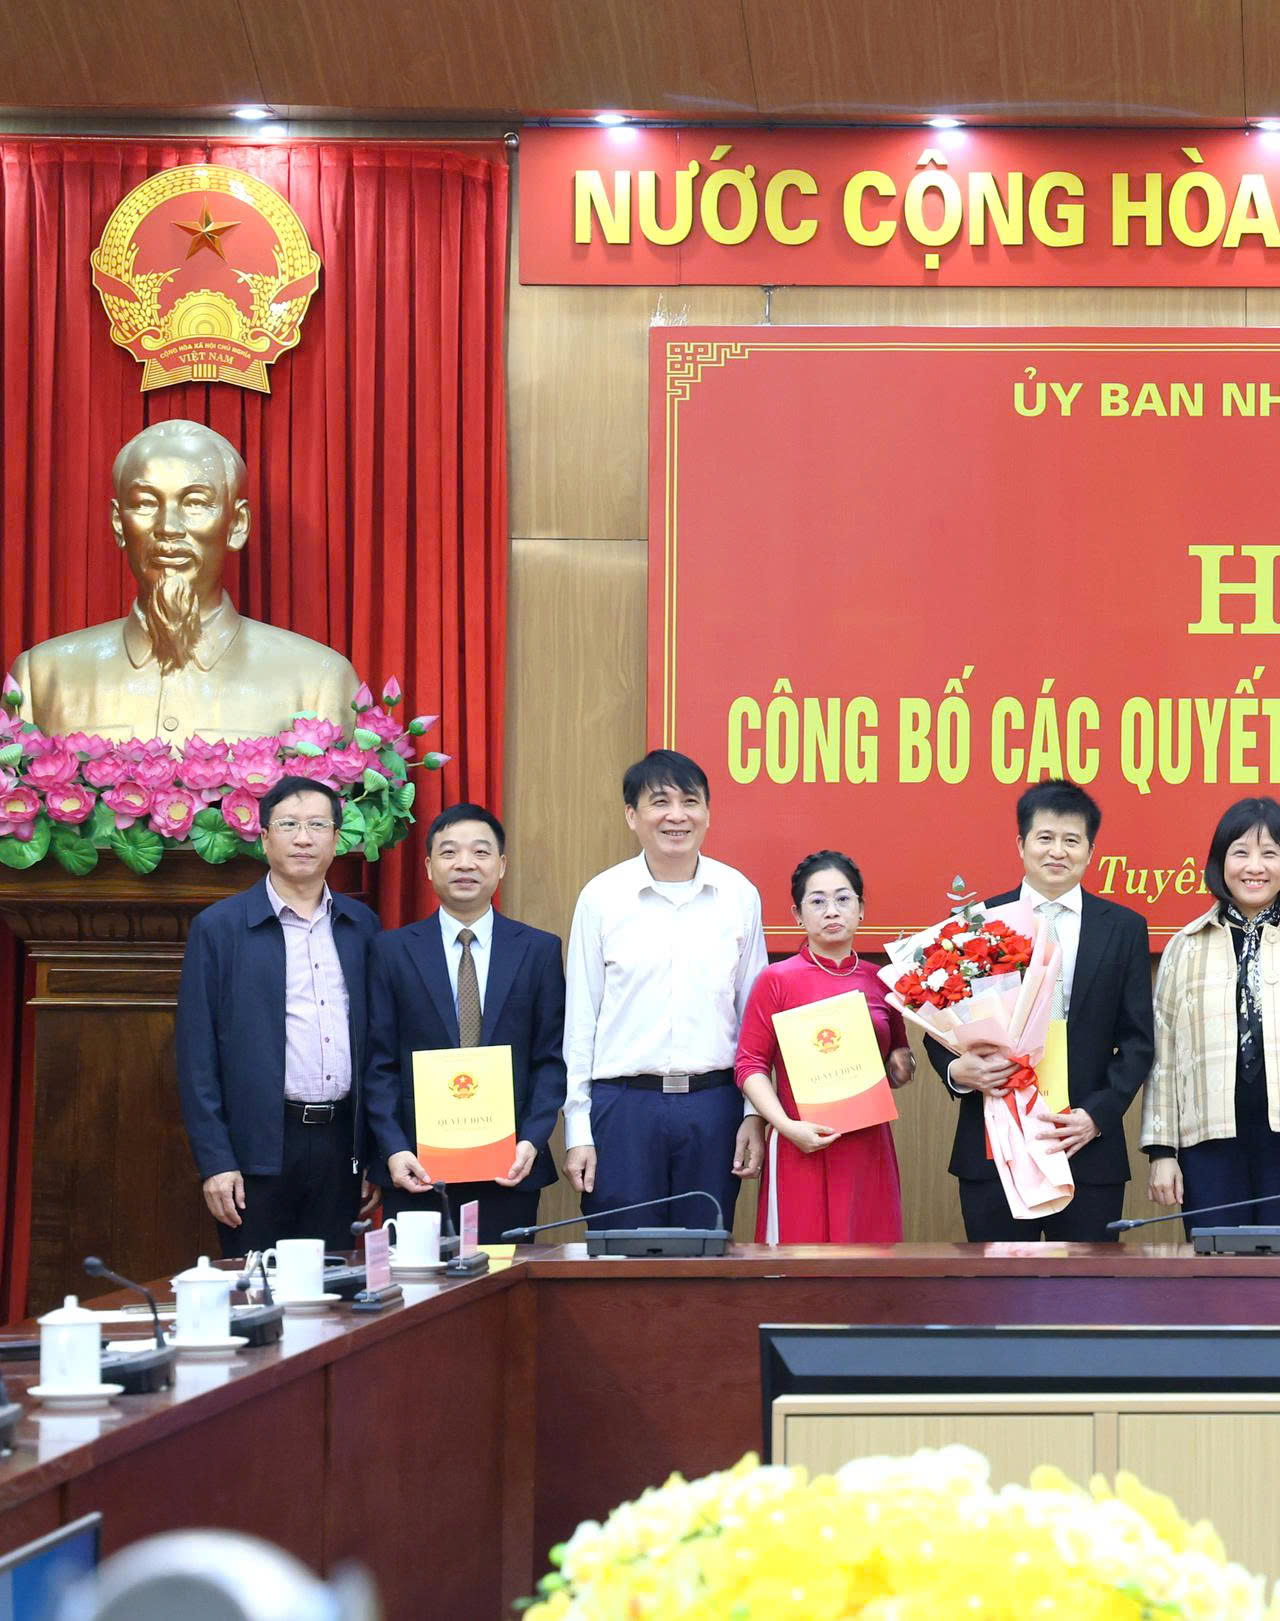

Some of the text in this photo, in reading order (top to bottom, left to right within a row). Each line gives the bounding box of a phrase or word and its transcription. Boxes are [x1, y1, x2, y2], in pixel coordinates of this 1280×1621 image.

[573, 144, 819, 247] NƯỚC
[843, 148, 1085, 270] CỘNG
[179, 350, 234, 364] VIỆT NAM
[1014, 365, 1083, 417] ỦY
[1101, 382, 1203, 417] BAN
[727, 677, 879, 785] CÔNG
[898, 664, 975, 785] BỐ
[990, 677, 1100, 785] CÁC
